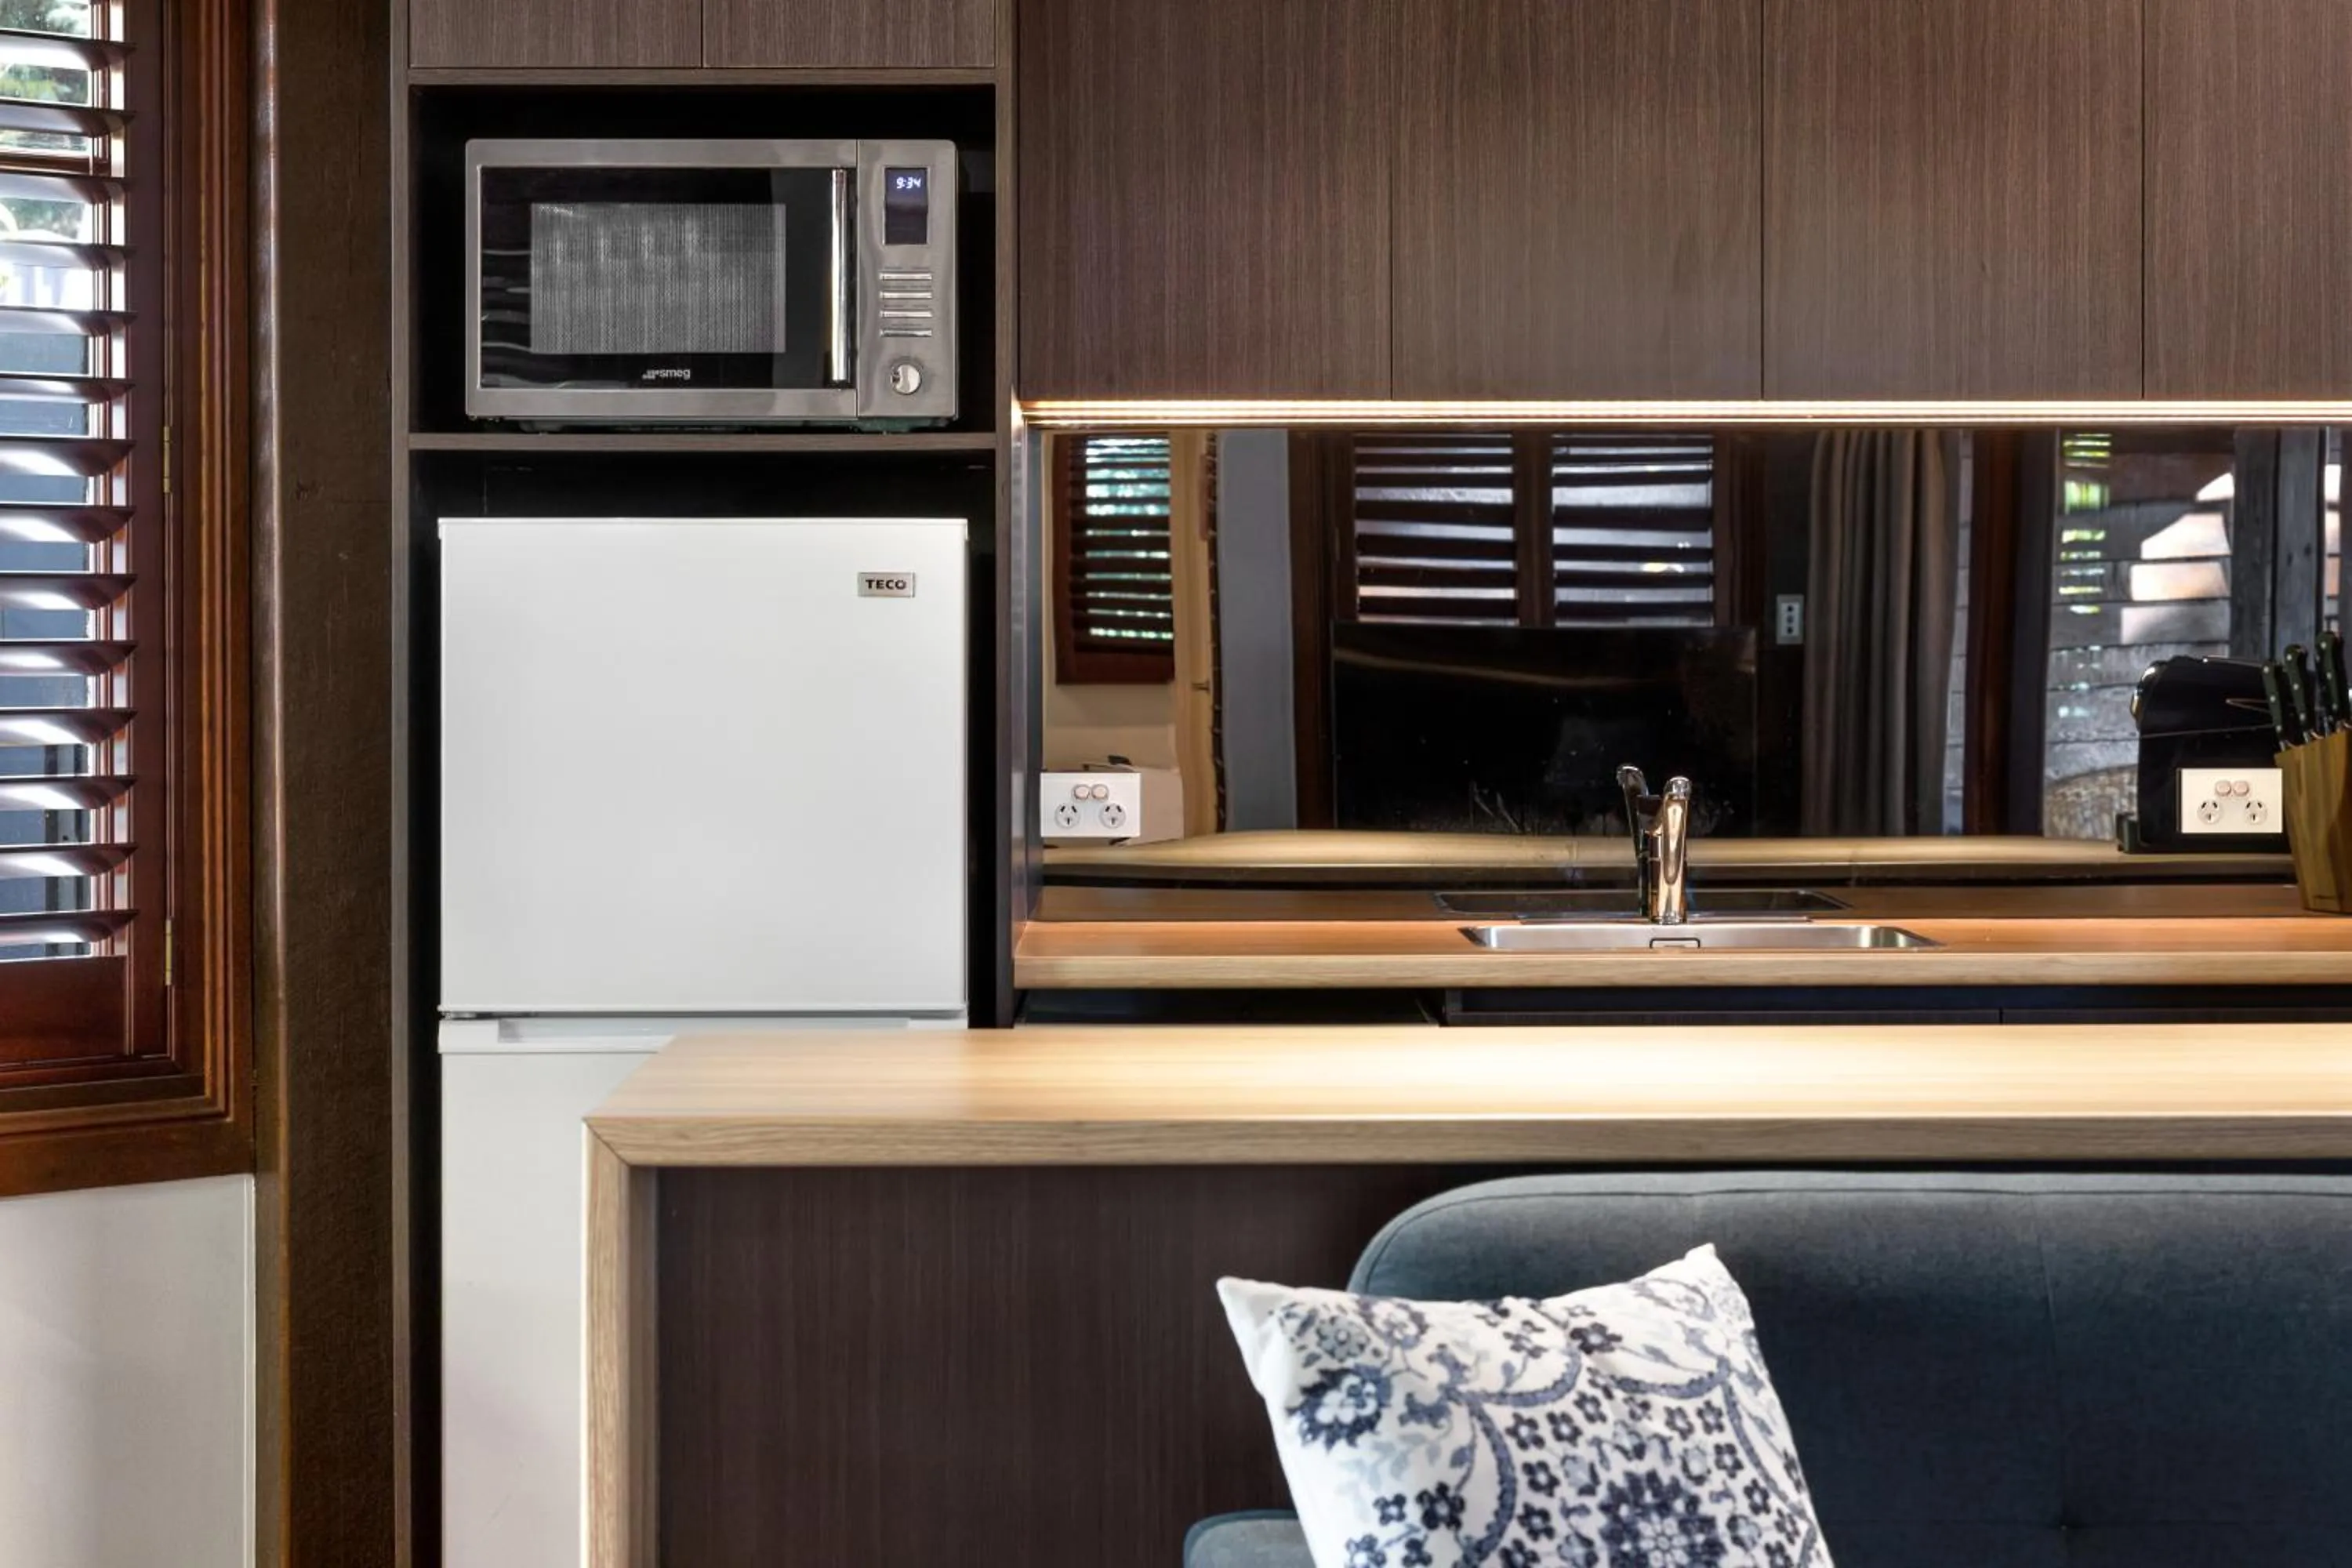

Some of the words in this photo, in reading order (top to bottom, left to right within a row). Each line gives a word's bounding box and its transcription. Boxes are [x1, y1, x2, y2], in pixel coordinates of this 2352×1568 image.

[896, 176, 921, 189] 9:34
[659, 368, 691, 380] smeg
[865, 579, 907, 590] TECO
